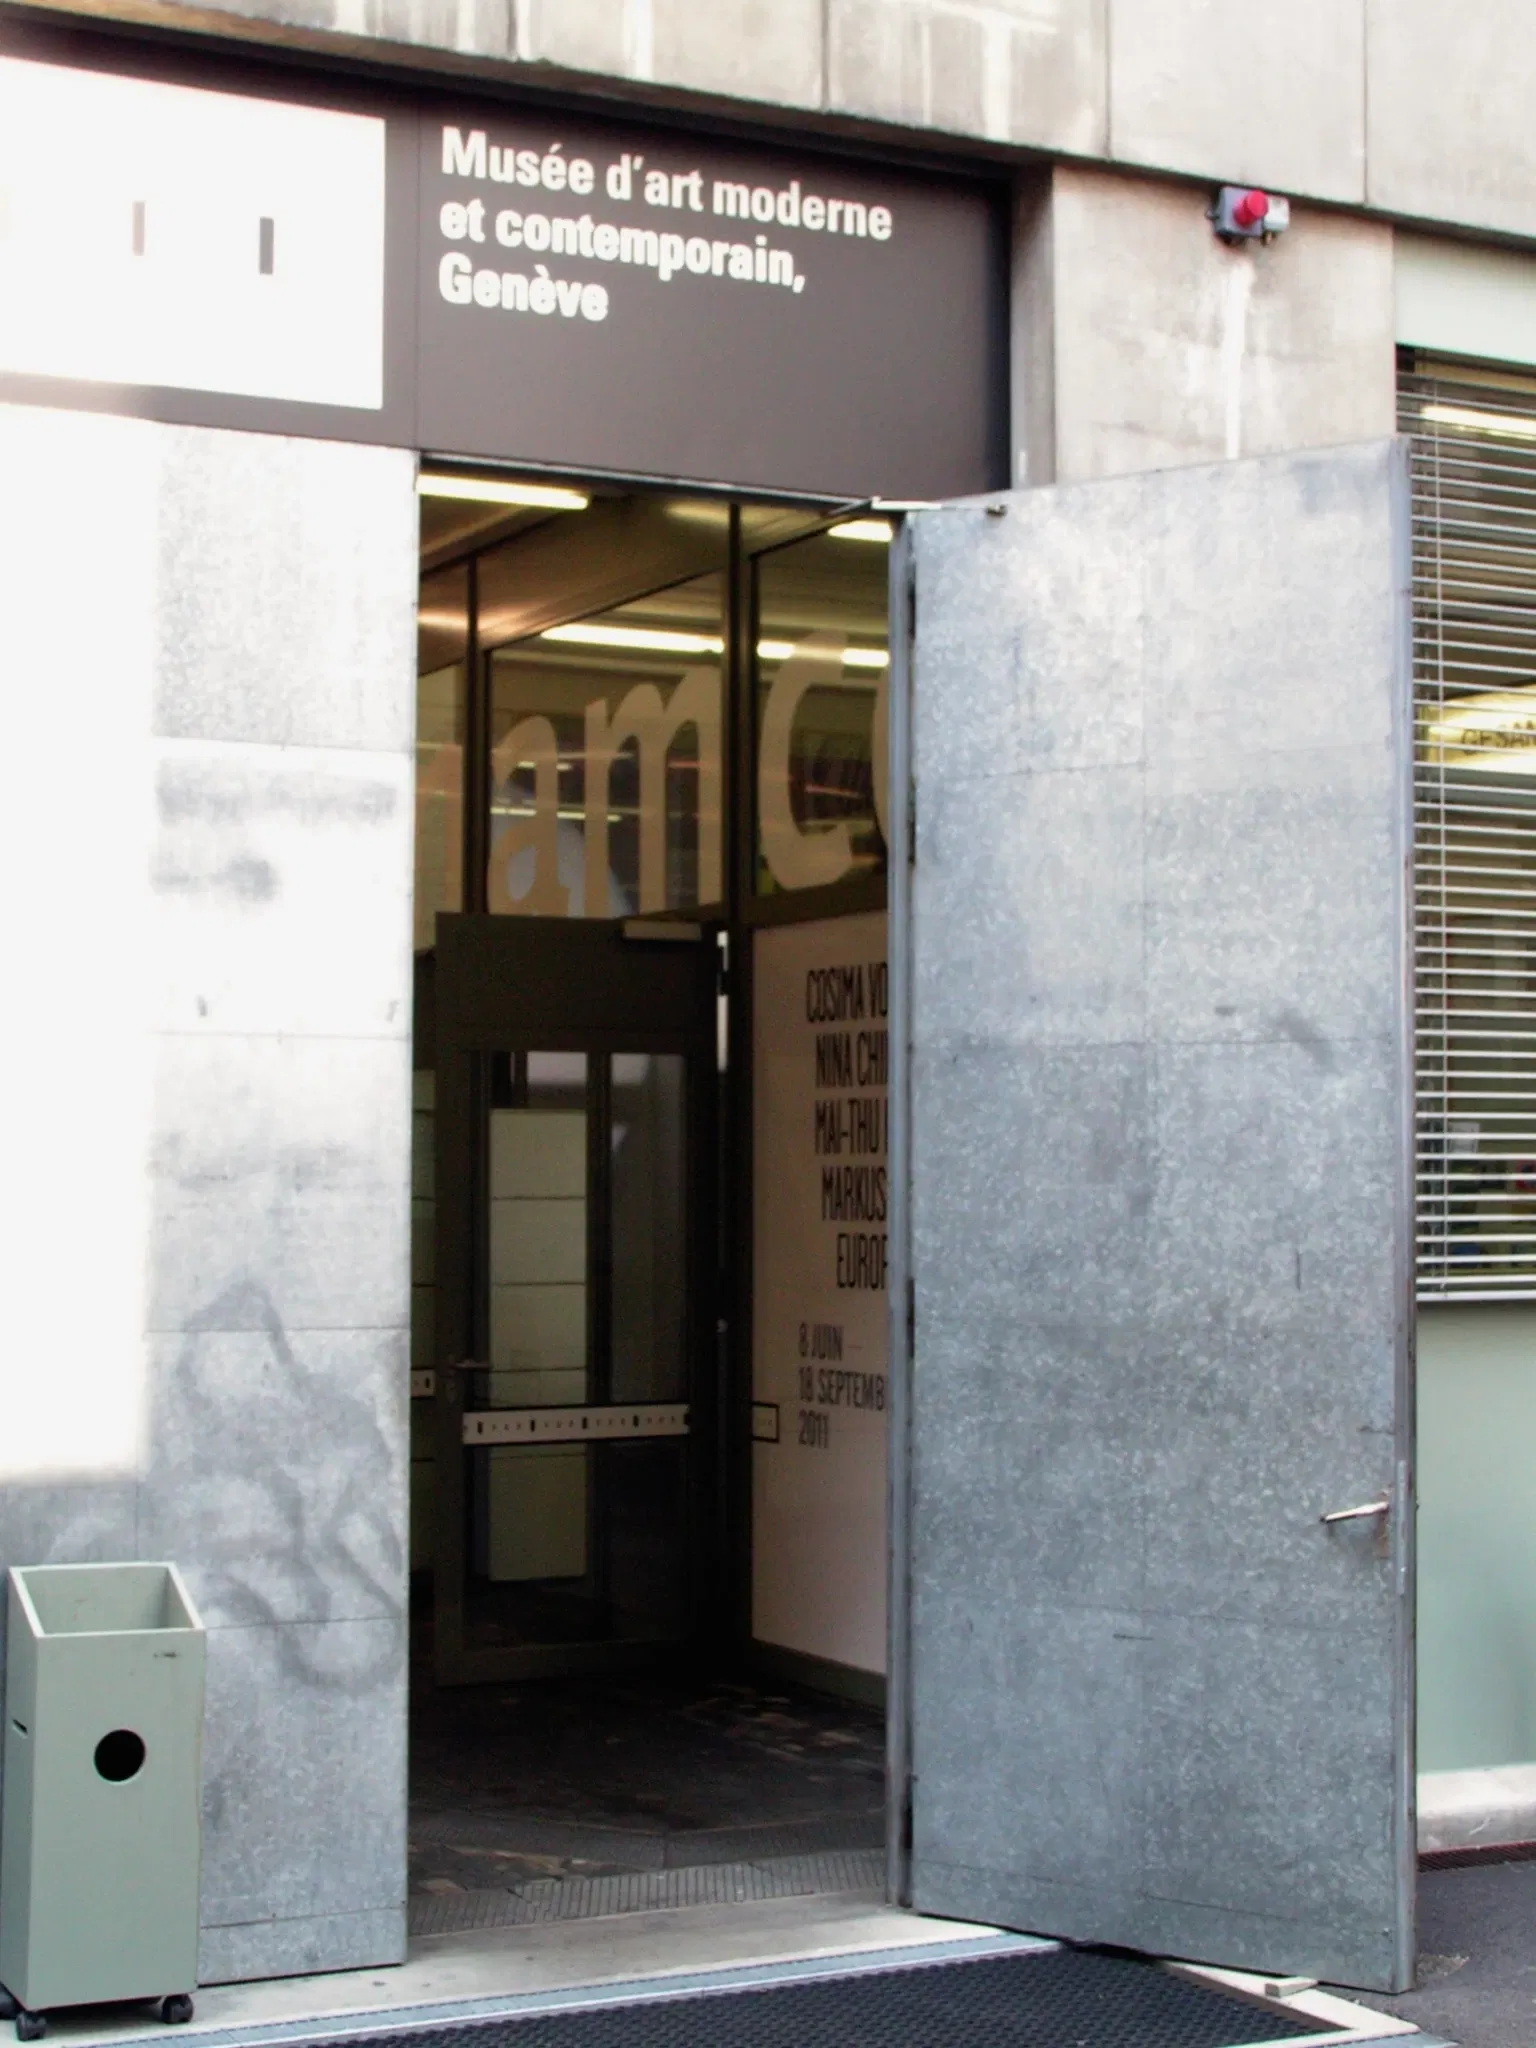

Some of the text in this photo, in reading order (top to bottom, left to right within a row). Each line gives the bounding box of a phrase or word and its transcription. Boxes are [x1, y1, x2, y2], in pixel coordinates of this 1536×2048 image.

[441, 125, 893, 241] Musée d'art moderne
[439, 198, 806, 293] et contemporain,
[438, 251, 609, 322] Genève
[806, 966, 865, 1023] COSIMA
[815, 1032, 853, 1088] NINA
[814, 1098, 880, 1155] MAI-THU
[821, 1165, 888, 1222] MARKUS
[798, 1320, 845, 1361] 8 JUIN
[799, 1409, 829, 1449] 2011
